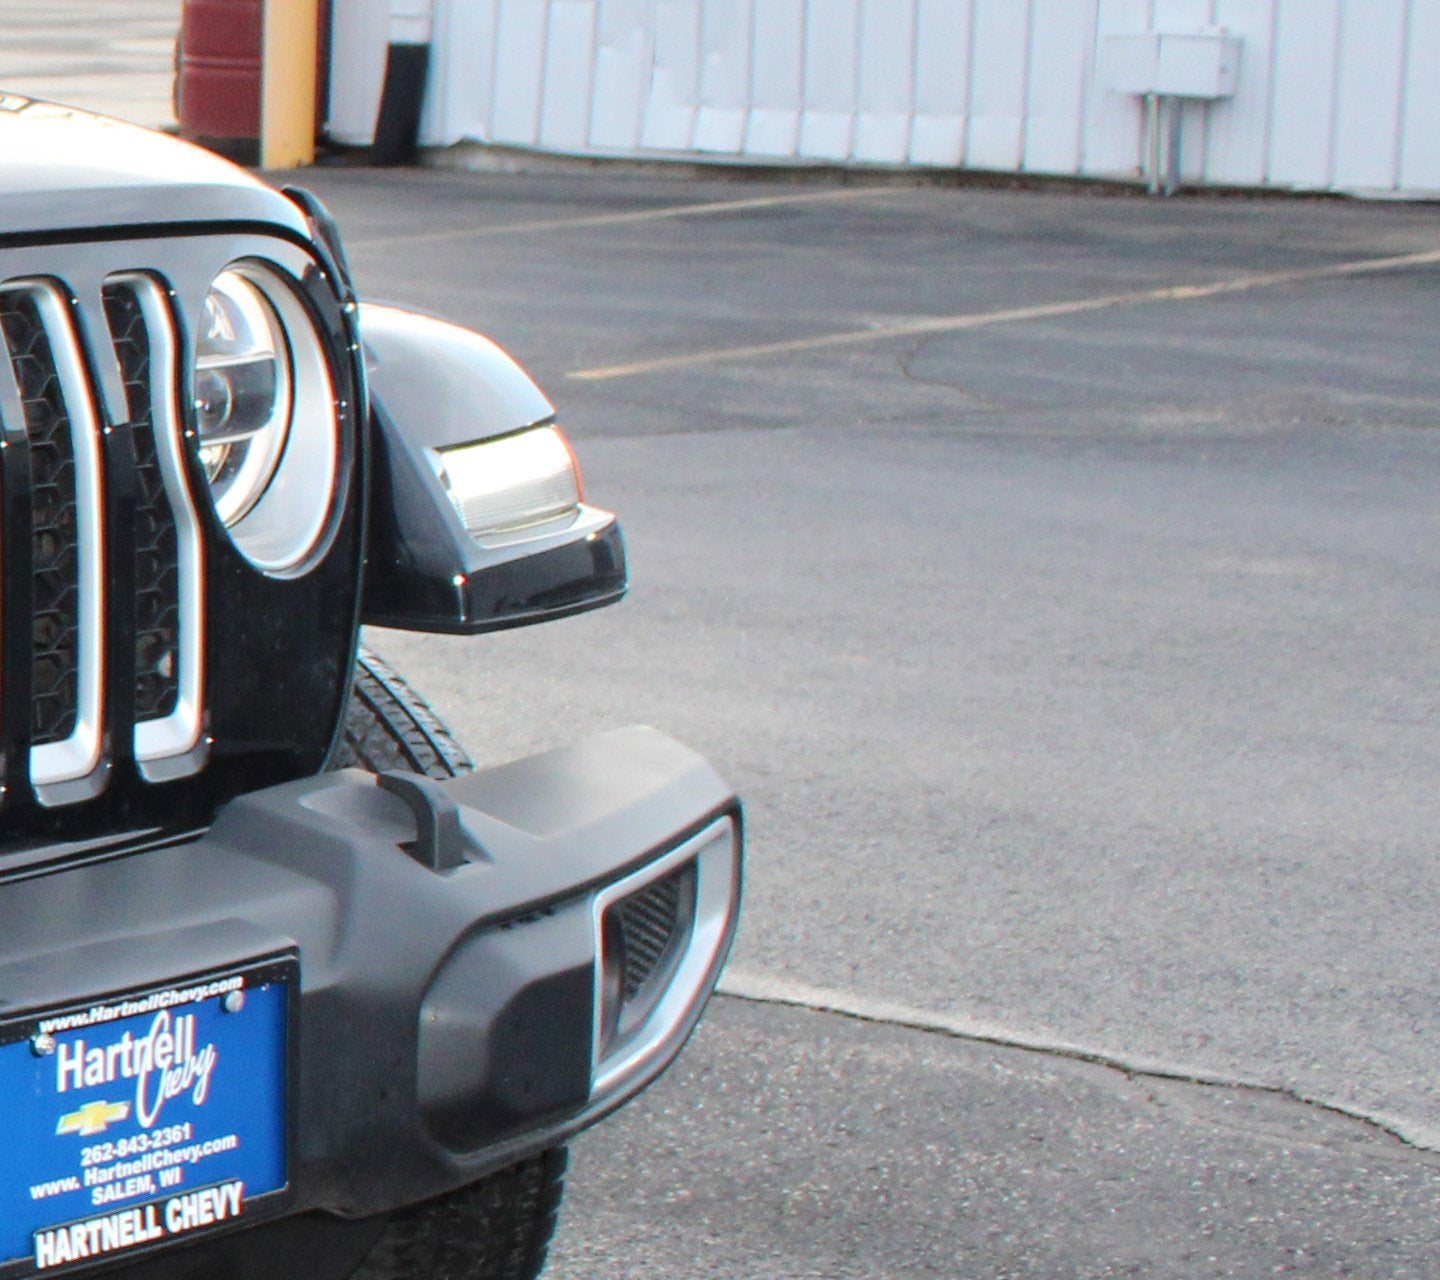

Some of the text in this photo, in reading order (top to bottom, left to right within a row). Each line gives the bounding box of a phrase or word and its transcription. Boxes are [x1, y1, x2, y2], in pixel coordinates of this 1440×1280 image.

[39, 976, 243, 1033] www.HartnellChevy.com
[56, 1013, 194, 1092] Hartnell
[136, 1010, 216, 1128] Chevy
[30, 1134, 237, 1200] www. HartnellChevy.com
[81, 1122, 191, 1166] 262-843-2361
[91, 1168, 182, 1205] SALEM, WI
[35, 1180, 243, 1268] HARTNELL CHEVY
